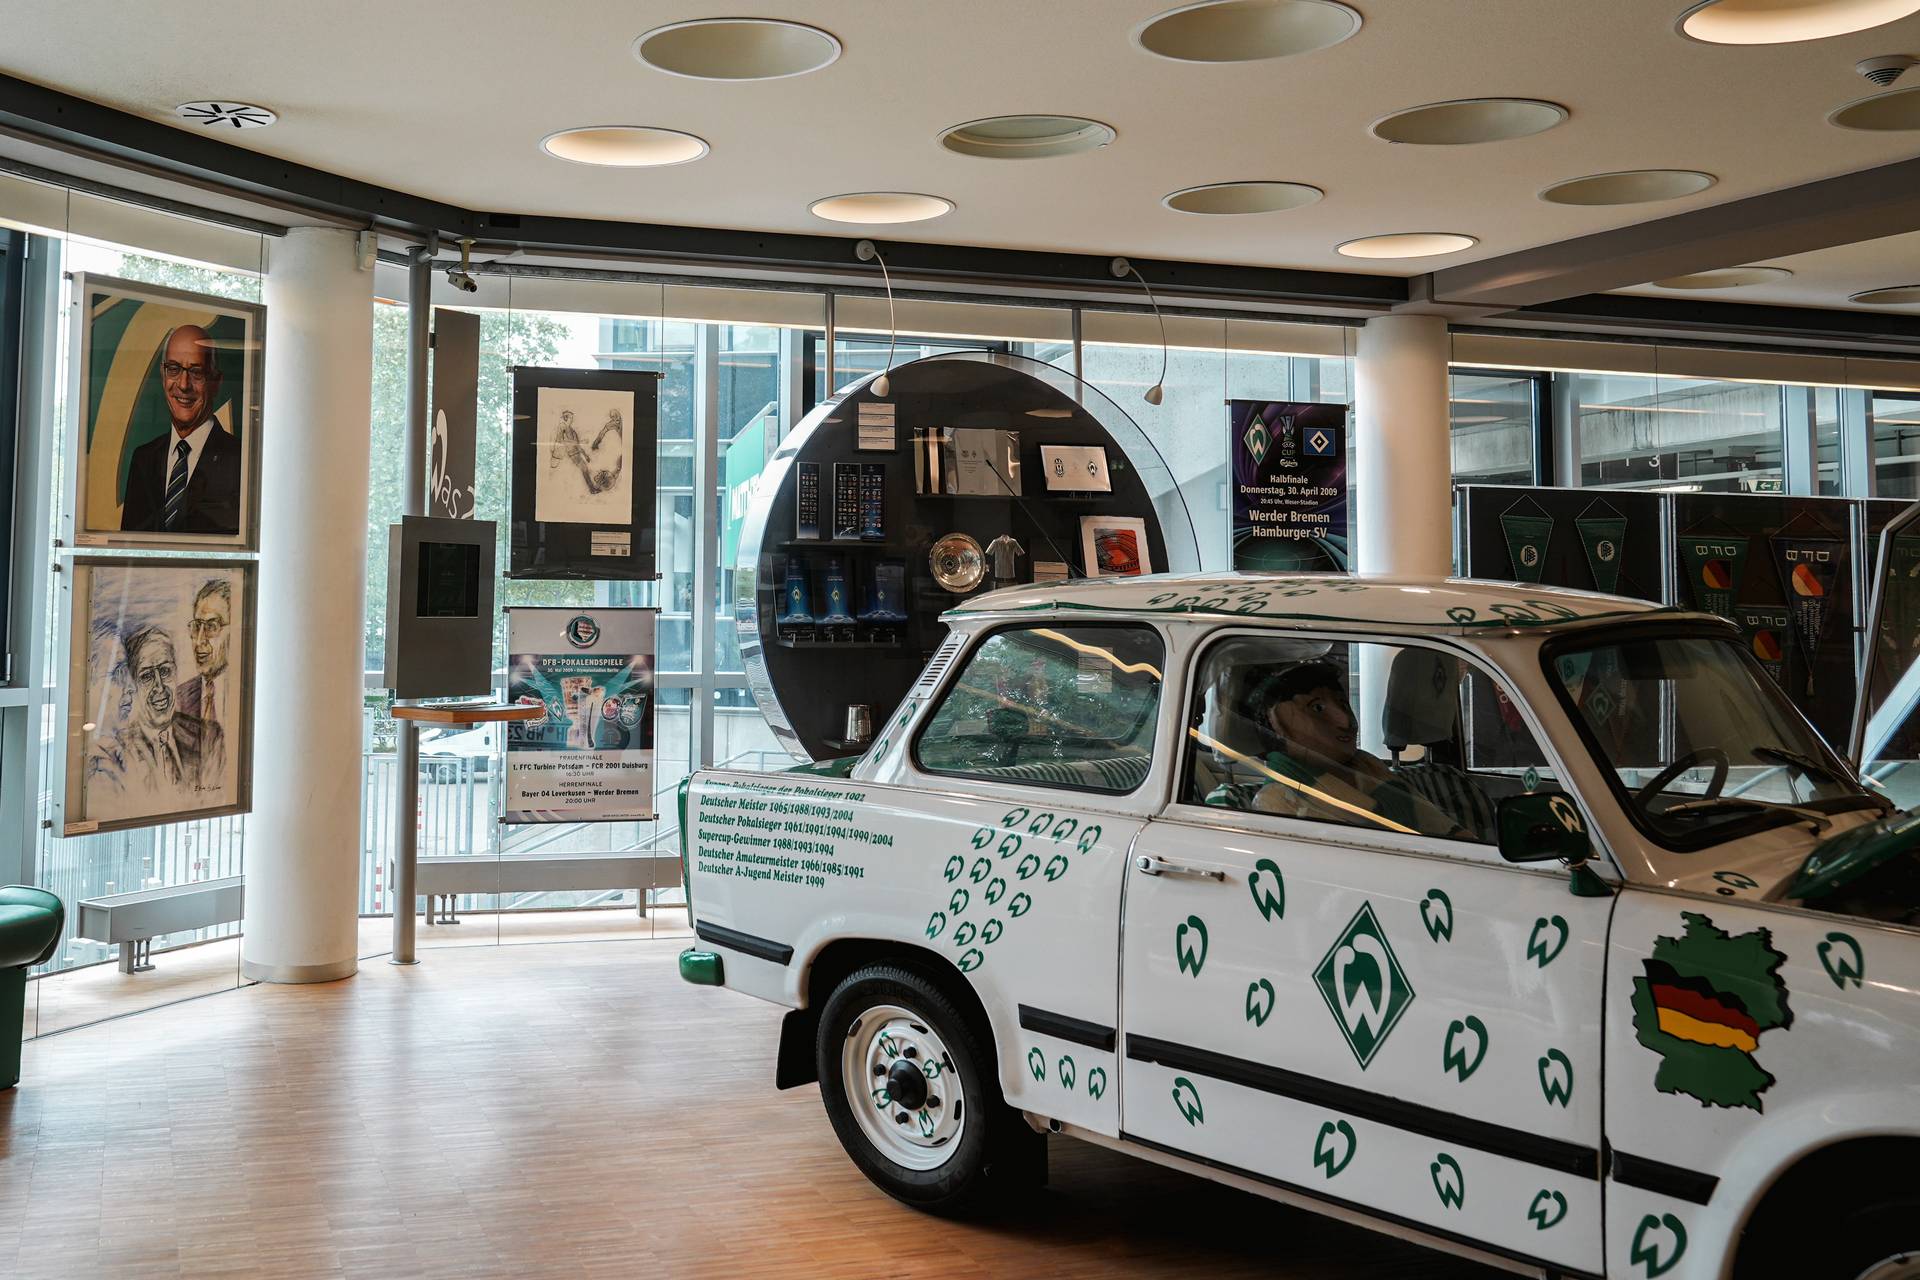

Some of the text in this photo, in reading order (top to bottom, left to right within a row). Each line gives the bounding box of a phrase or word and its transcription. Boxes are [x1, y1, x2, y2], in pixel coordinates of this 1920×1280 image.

[1270, 475, 1309, 484] Halbfinale
[1240, 485, 1338, 497] Donnerstag, 30. April 2009
[1249, 510, 1330, 523] Werder Bremen
[1252, 526, 1327, 540] Hamburger SV
[542, 658, 624, 666] DFB-POKALENDSPIELE
[622, 762, 649, 770] Duisburg
[521, 790, 539, 798] Bayer
[700, 794, 854, 822] Deutscher Meister 1965/1988/1993/2004
[699, 811, 894, 847] Deutscher Pokalsieger 1961/1991/1994/1999/2004
[698, 828, 834, 856] Supercup-Gewinner 1988/1993/1994
[698, 846, 864, 878] Deutscher Amateurmeister 1966/1985/1991
[698, 861, 825, 888] Deutscher A-Jugend Meister 1999
